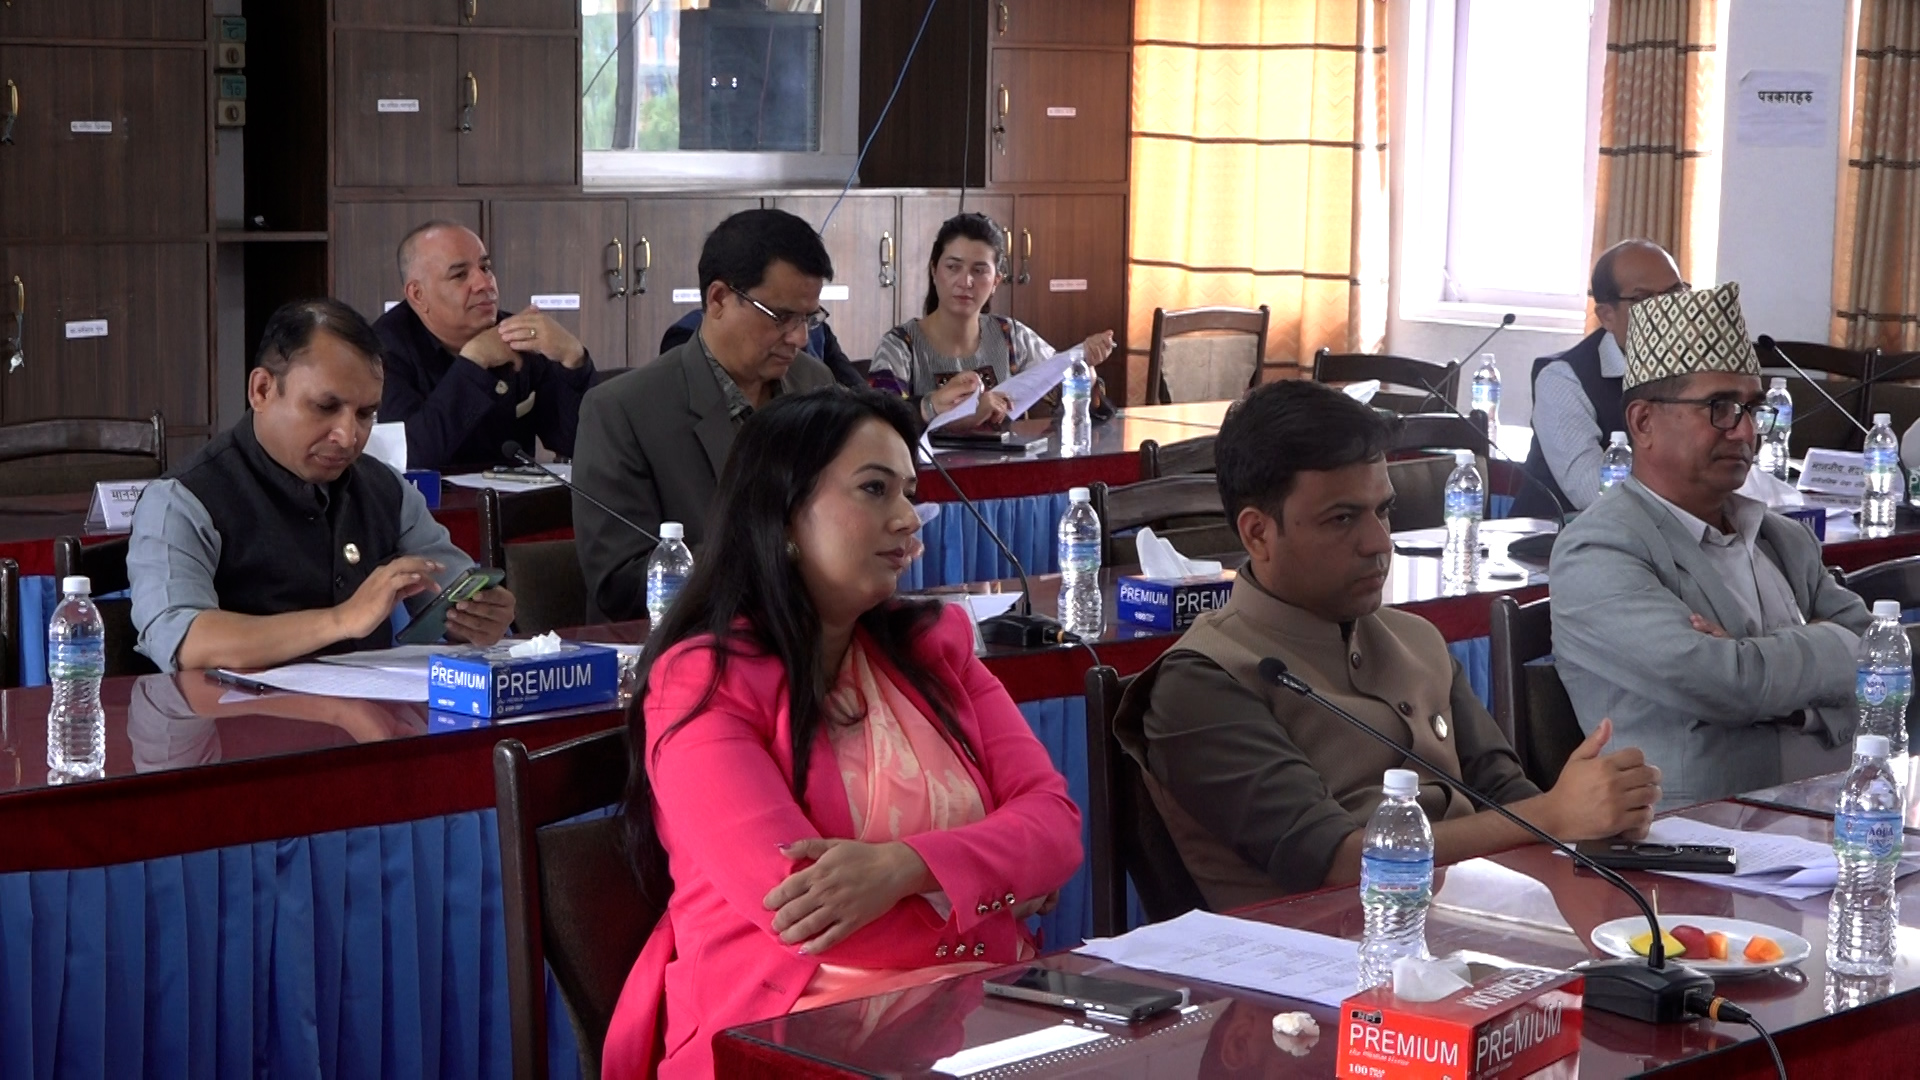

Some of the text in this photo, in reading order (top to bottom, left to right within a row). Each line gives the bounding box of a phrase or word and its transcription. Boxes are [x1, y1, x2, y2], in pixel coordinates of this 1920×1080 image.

[1120, 584, 1168, 606] PREMIUM
[1176, 589, 1230, 614] PREMI
[431, 664, 485, 690] PREMIUM
[496, 663, 592, 698] PREMIUM
[1349, 1023, 1459, 1067] PREMIUM
[1475, 1000, 1562, 1072] PREMIUM
[1348, 1062, 1368, 1076] 100
